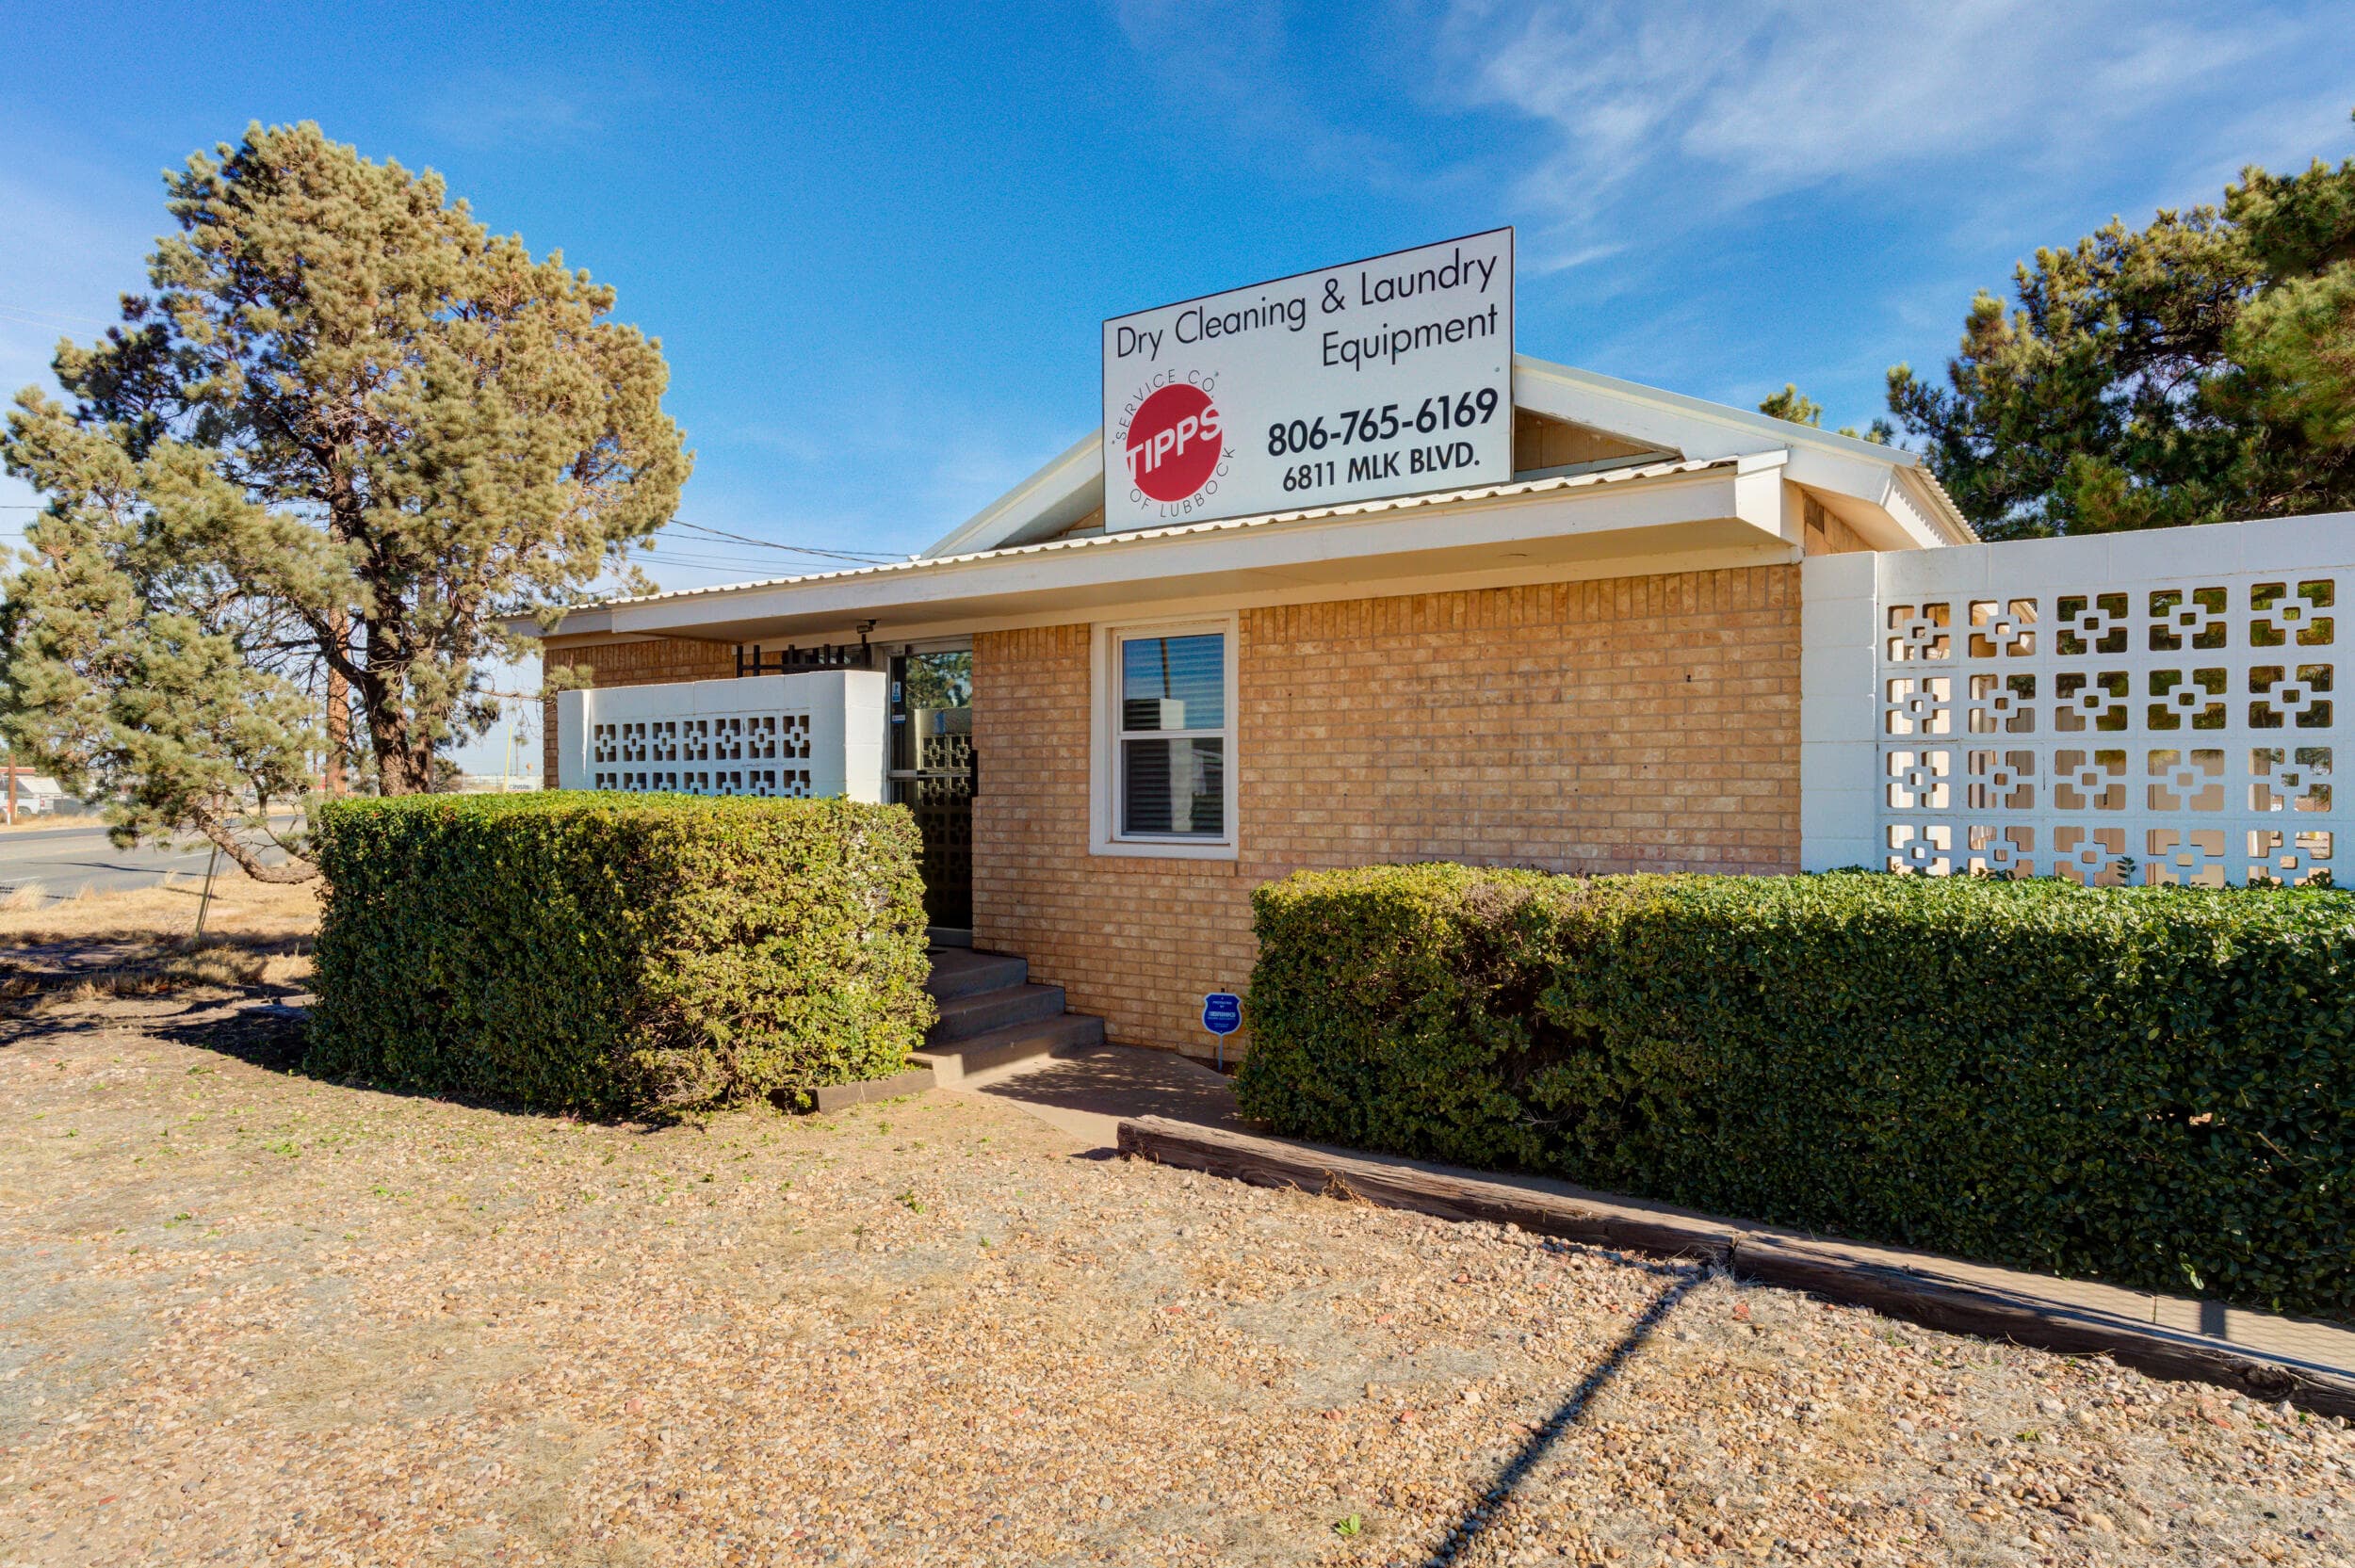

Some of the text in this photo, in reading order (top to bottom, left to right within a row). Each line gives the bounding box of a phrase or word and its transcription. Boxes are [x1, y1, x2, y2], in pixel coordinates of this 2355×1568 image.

[1117, 248, 1498, 362] Dry Cleaning & Laundry
[1323, 303, 1498, 372] Equipment
[1115, 368, 1176, 441] SERVICE
[1268, 387, 1499, 457] 806-765-6169
[1126, 403, 1223, 480] TIPPS
[1282, 442, 1480, 492] 6811 MLK BLVD.
[1129, 446, 1236, 518] OF LUBBOCK
